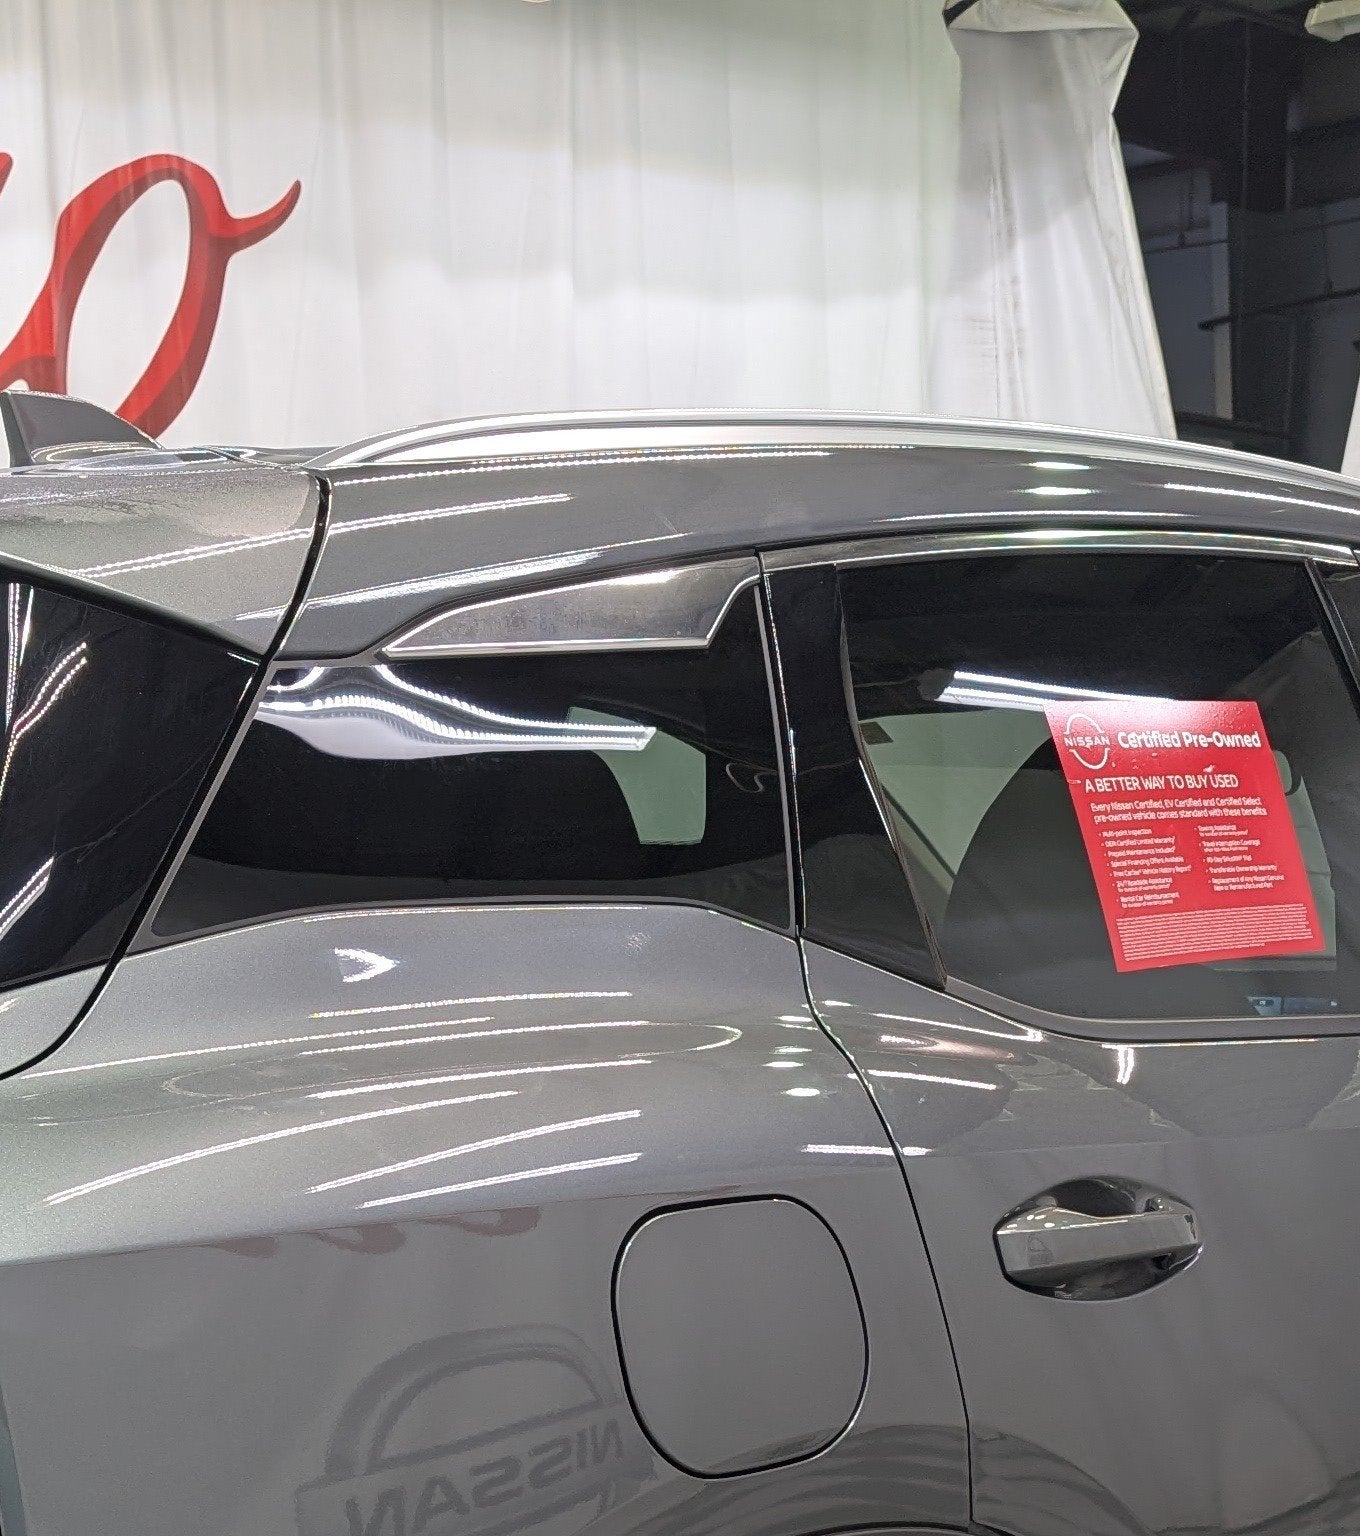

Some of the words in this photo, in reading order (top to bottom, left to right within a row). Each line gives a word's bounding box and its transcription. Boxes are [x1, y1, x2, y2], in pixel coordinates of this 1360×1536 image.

[1064, 736, 1110, 748] NISSAN
[1117, 731, 1181, 748] Certified
[1182, 730, 1262, 748] Pre-Owned
[1086, 778, 1096, 793] A
[1095, 776, 1141, 793] BETTER
[1140, 775, 1165, 790] WAY
[1165, 775, 1184, 789] TO
[1184, 774, 1207, 789] BUY
[1209, 774, 1239, 788] USED
